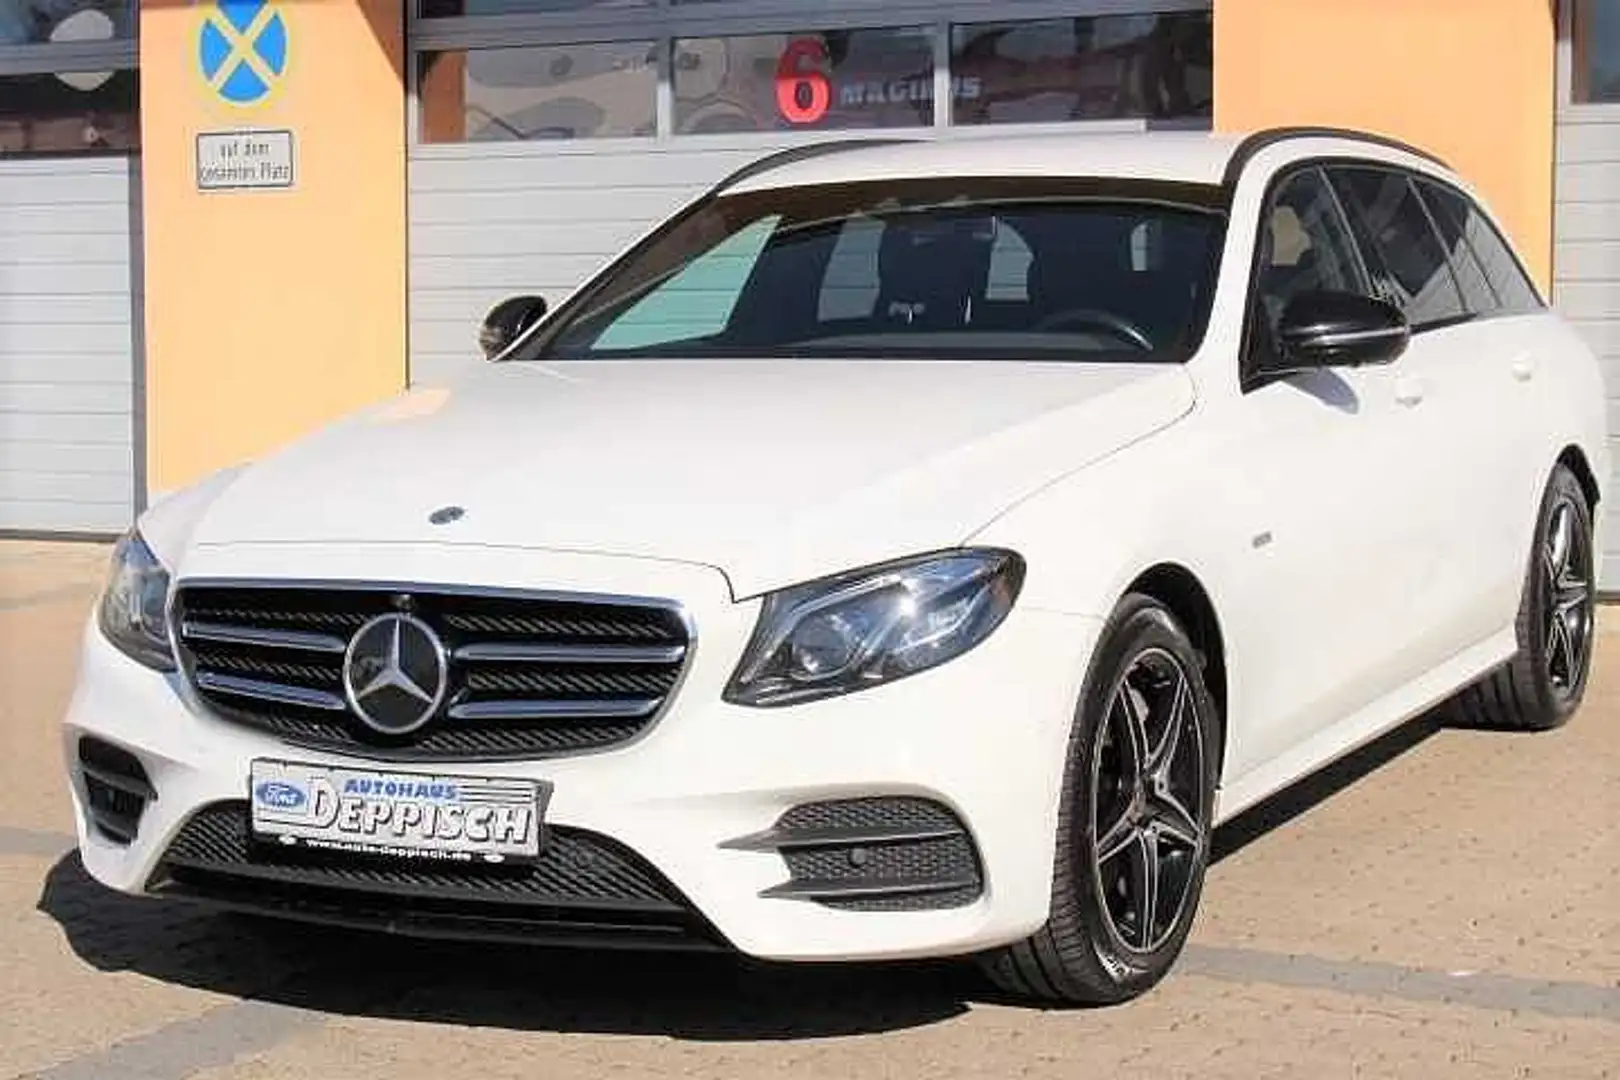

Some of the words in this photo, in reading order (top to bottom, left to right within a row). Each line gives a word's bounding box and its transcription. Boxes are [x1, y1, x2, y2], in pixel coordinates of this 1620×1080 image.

[776, 37, 830, 124] 6
[261, 783, 300, 806] Ford
[308, 777, 532, 844] DEPPISCH
[344, 779, 460, 799] AUTOHAUS
